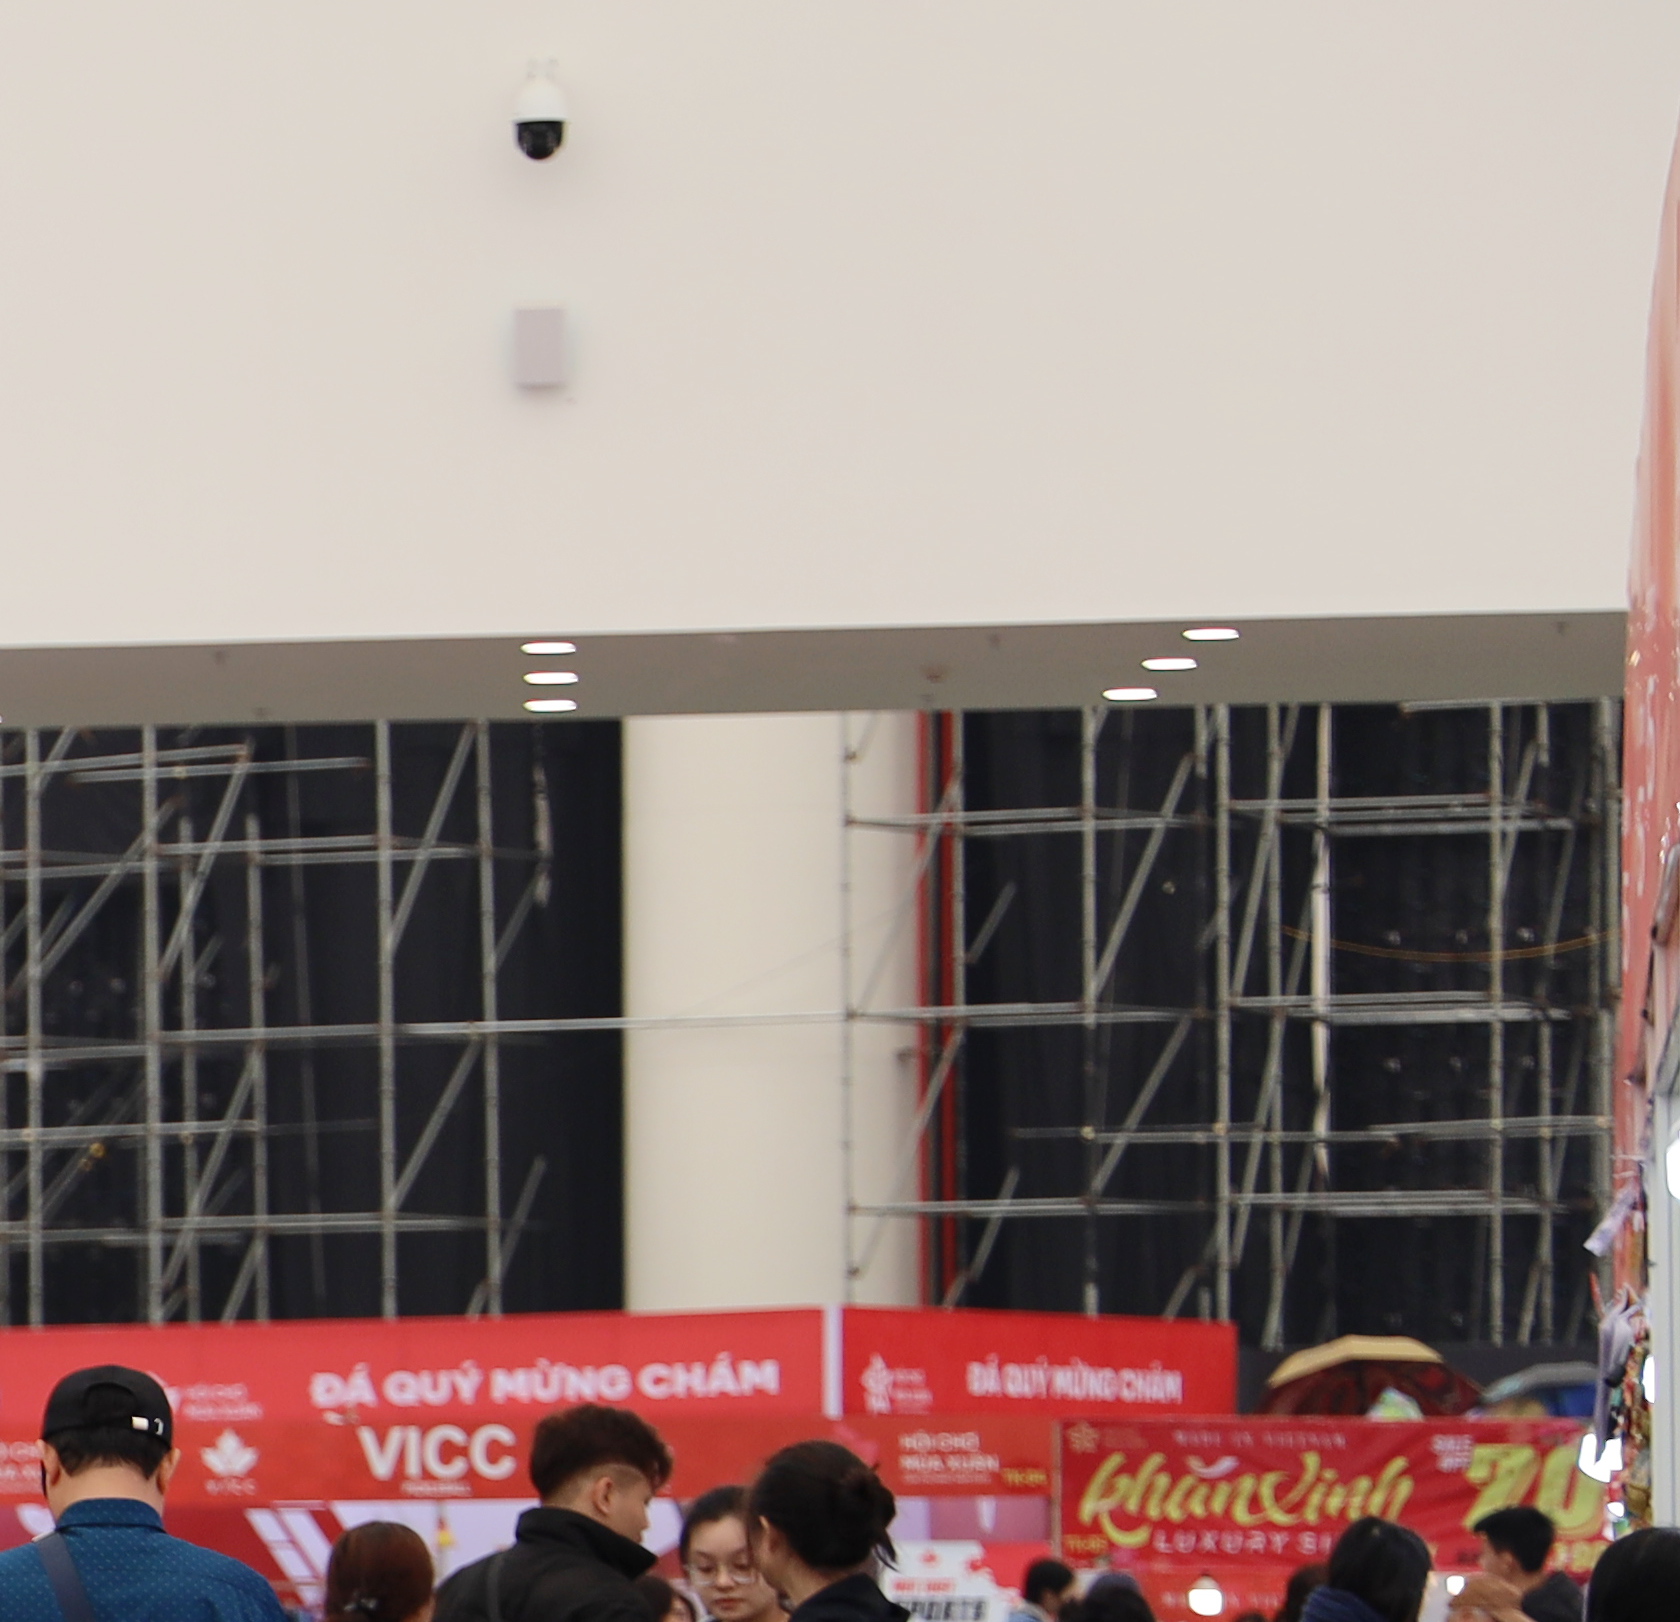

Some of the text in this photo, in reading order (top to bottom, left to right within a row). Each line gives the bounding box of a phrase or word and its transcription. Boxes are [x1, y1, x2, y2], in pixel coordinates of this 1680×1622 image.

[310, 1363, 376, 1409] ĐÁ
[383, 1359, 484, 1407] QUÝ
[359, 1425, 516, 1481] VICC
